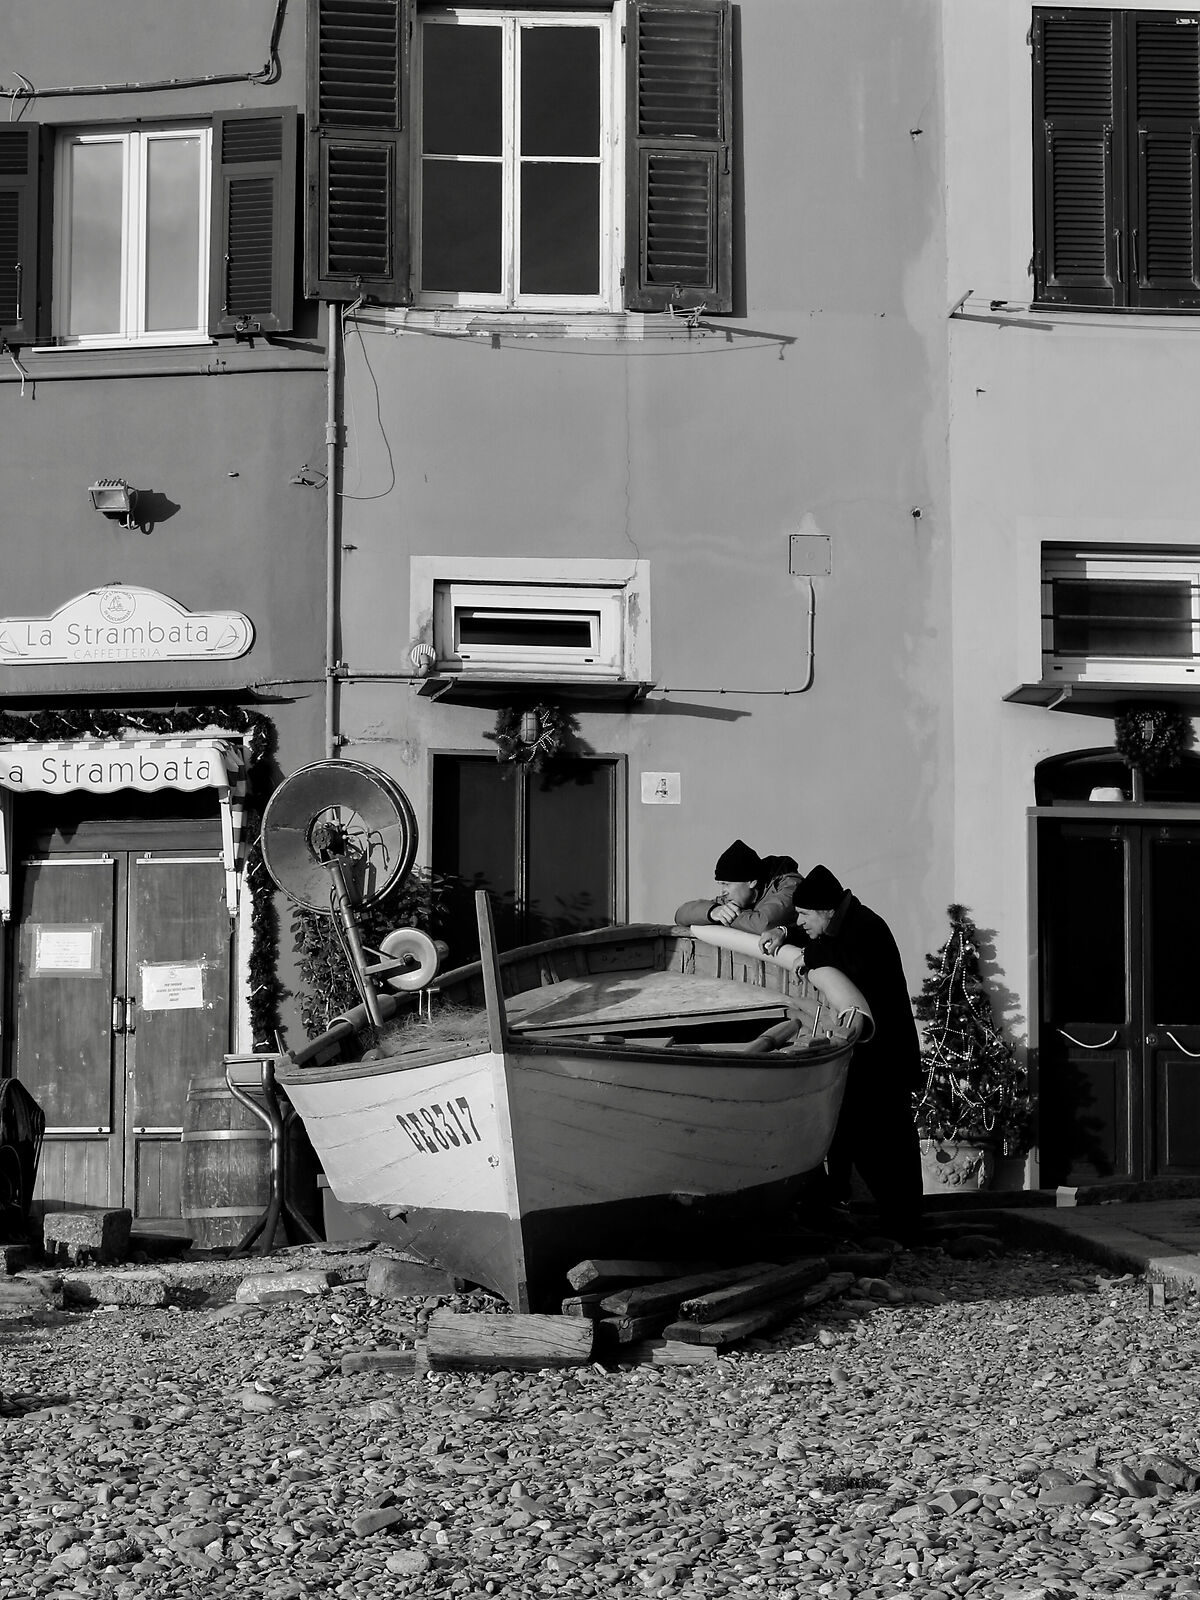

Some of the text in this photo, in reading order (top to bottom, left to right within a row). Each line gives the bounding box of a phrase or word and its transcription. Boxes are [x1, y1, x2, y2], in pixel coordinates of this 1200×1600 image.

[27, 621, 209, 646] La Strambata
[73, 648, 161, 659] CAFFETTERIA
[41, 755, 211, 785] Strambata
[396, 1097, 481, 1153] GE8317
